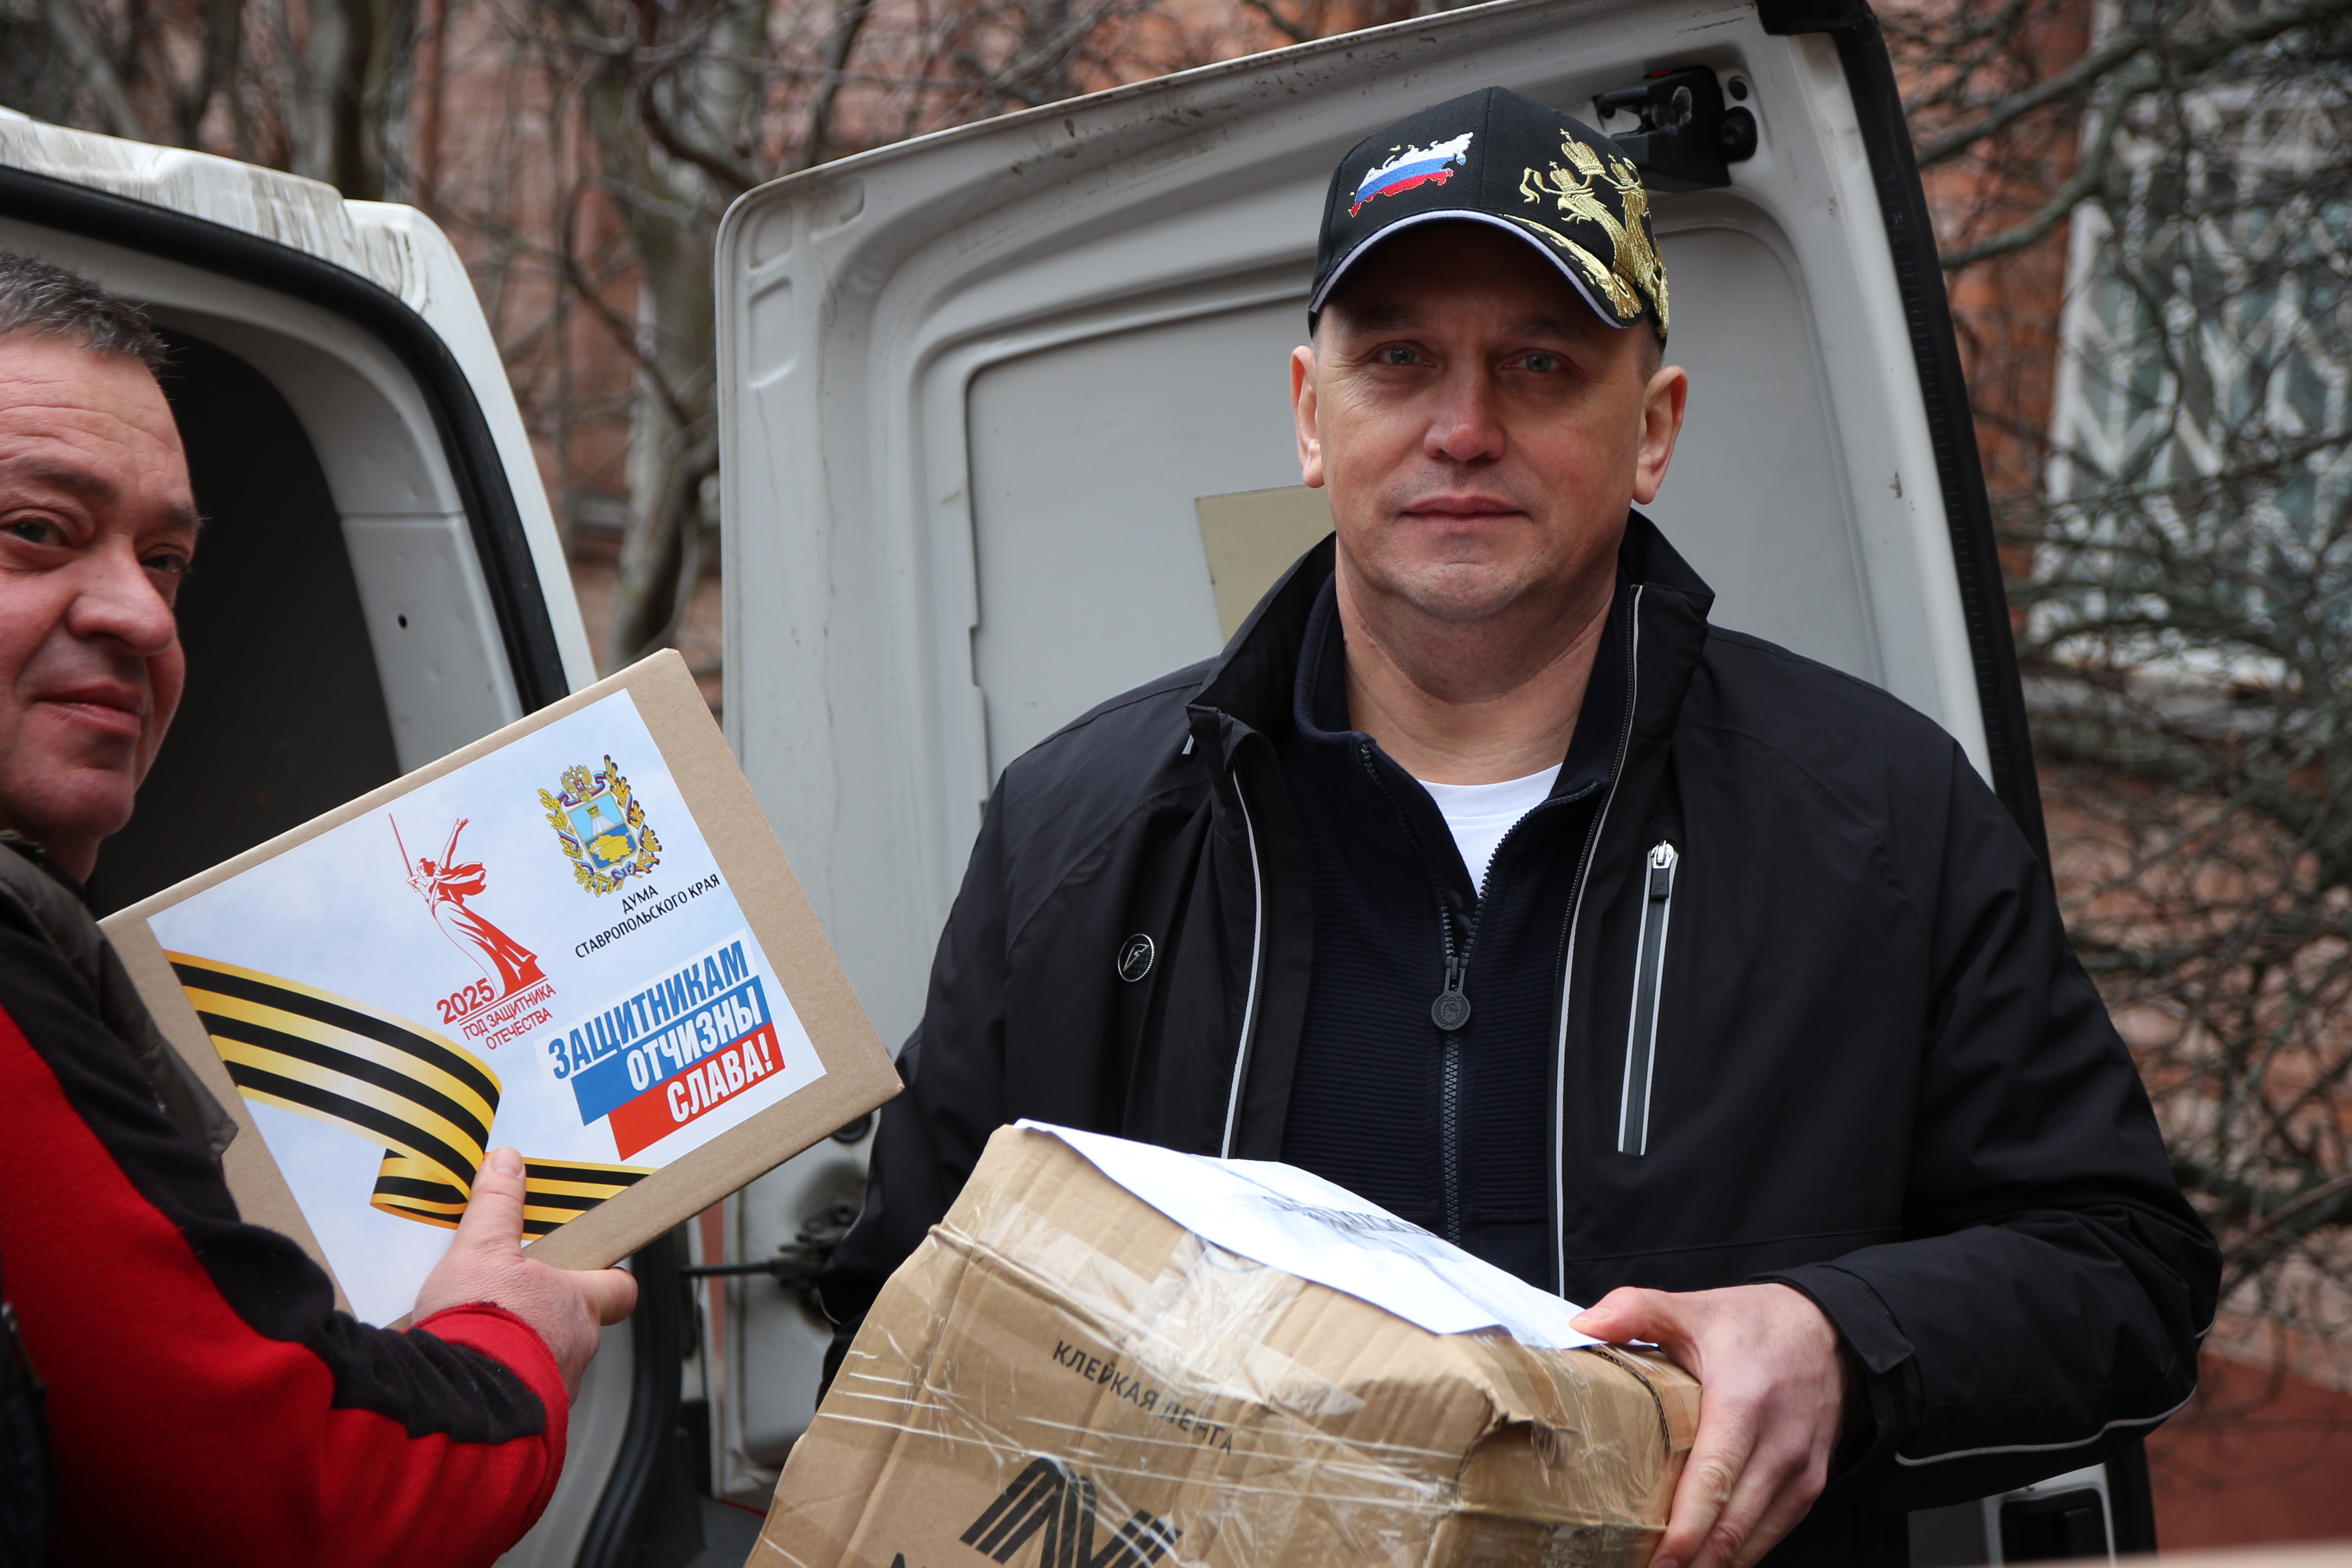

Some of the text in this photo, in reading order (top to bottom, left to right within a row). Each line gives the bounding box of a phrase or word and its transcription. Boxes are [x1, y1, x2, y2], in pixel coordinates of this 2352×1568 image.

[575, 873, 720, 958] СТАВРОПОЛЬСКОГО КРАЯ
[622, 885, 659, 915] ДУМА
[436, 977, 495, 1025] 2025
[462, 983, 557, 1040] ГОД ЗАЩИТНИКА
[485, 1007, 553, 1050] ОТЕЧЕСТВА
[548, 939, 750, 1079] ЗАЩИТНИКАМ
[626, 985, 763, 1091] ОТЧИЗНЫ
[666, 1032, 774, 1123] СЛАВА!
[1052, 1340, 1233, 1455] КЛЕЙКАЯ ЛЕНТА
